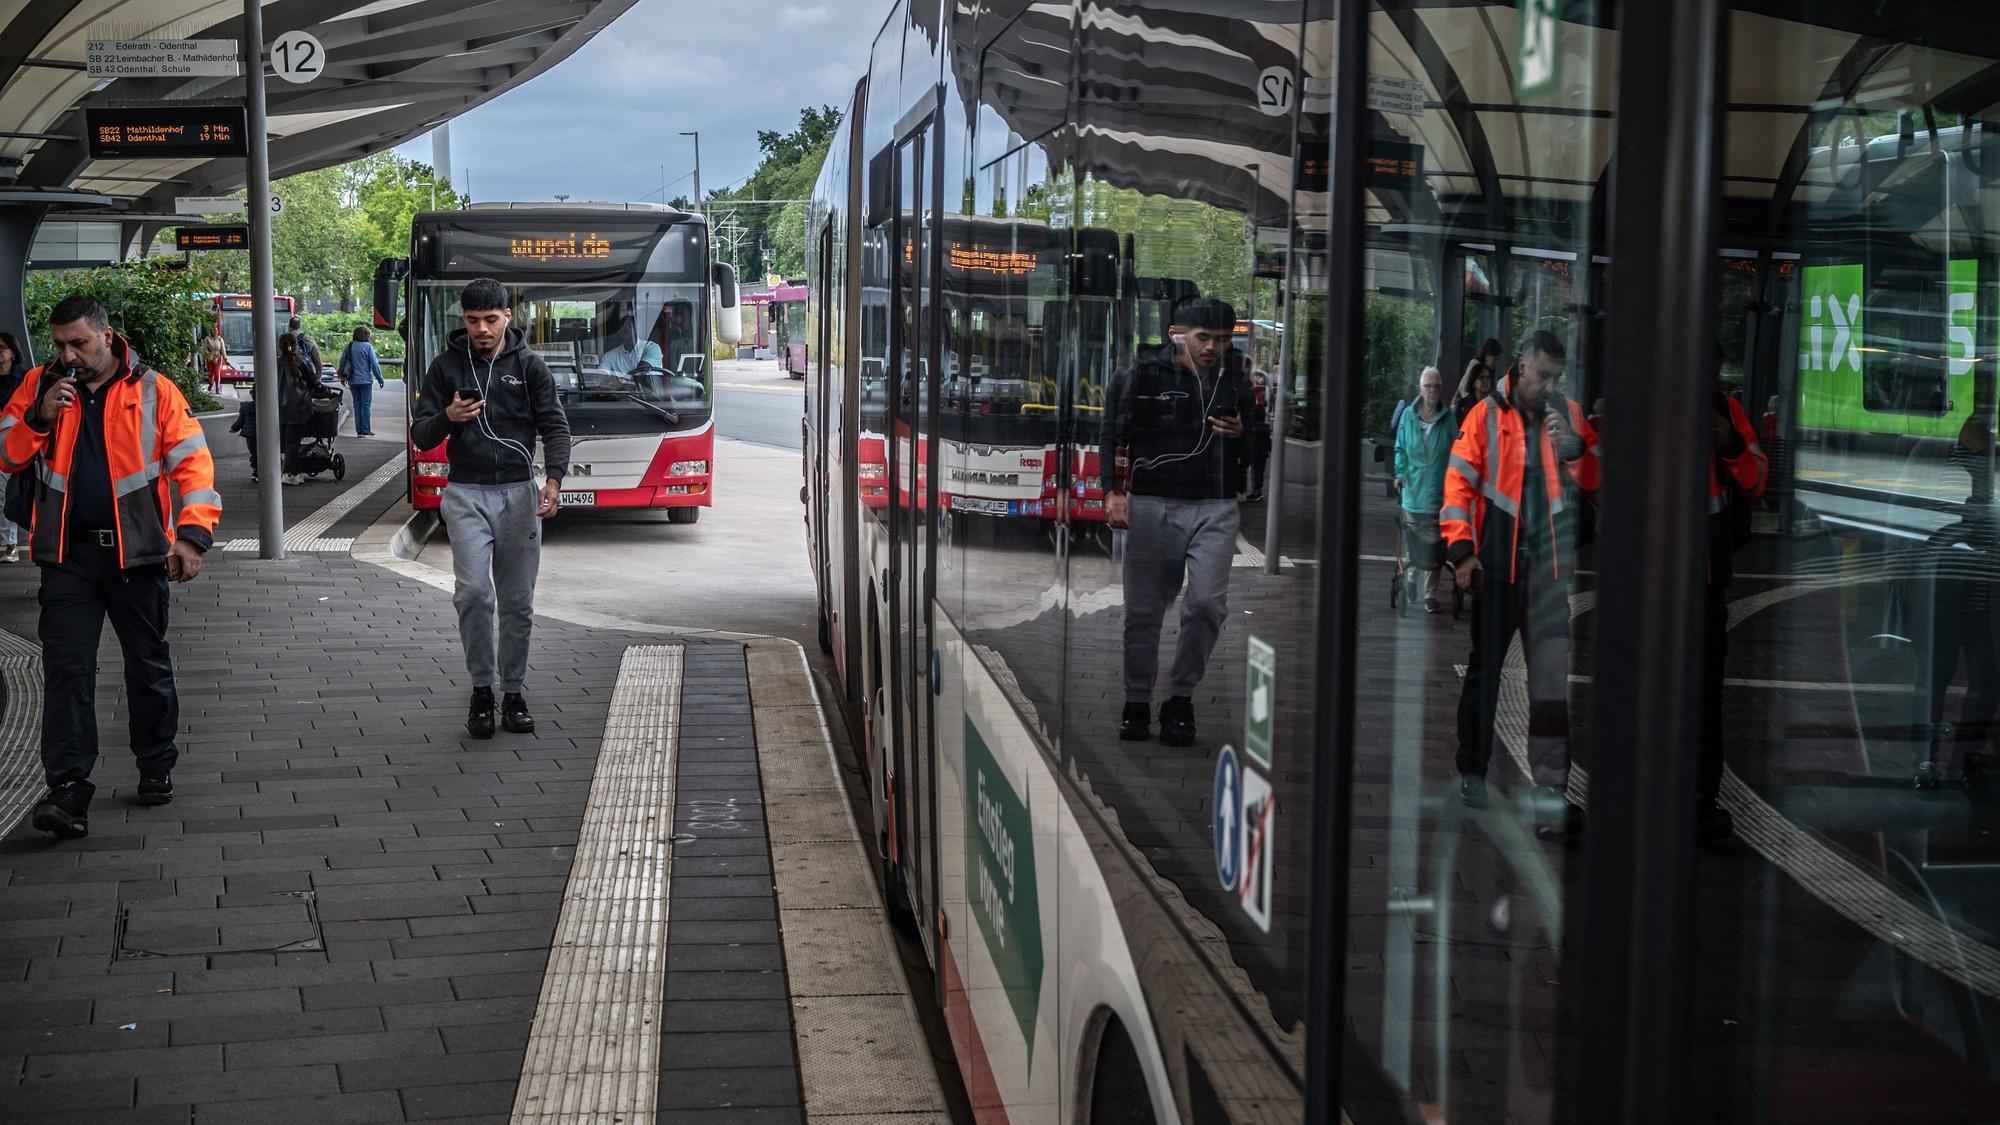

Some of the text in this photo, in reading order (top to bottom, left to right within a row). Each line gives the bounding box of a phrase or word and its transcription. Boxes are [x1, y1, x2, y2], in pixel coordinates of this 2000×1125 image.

[88, 43, 105, 51] 212
[116, 42, 151, 51] Edelrath
[159, 41, 198, 50] Odenthal
[88, 54, 102, 63] SB
[104, 54, 115, 63] 22
[116, 54, 165, 63] Leimbacher
[167, 54, 177, 62] B.
[183, 53, 236, 62] Mathildenhof
[275, 40, 317, 73] 12
[89, 64, 191, 74] SB 42 Odenthal, Schule
[99, 126, 121, 135] SB22
[126, 125, 185, 135] Mathildenhof
[99, 133, 230, 143] SB42 Odenthal 19 Min
[271, 196, 281, 212] 3
[511, 232, 611, 262] wupsi.de
[976, 767, 1015, 906] Einstieg
[978, 853, 1006, 950] vorne
